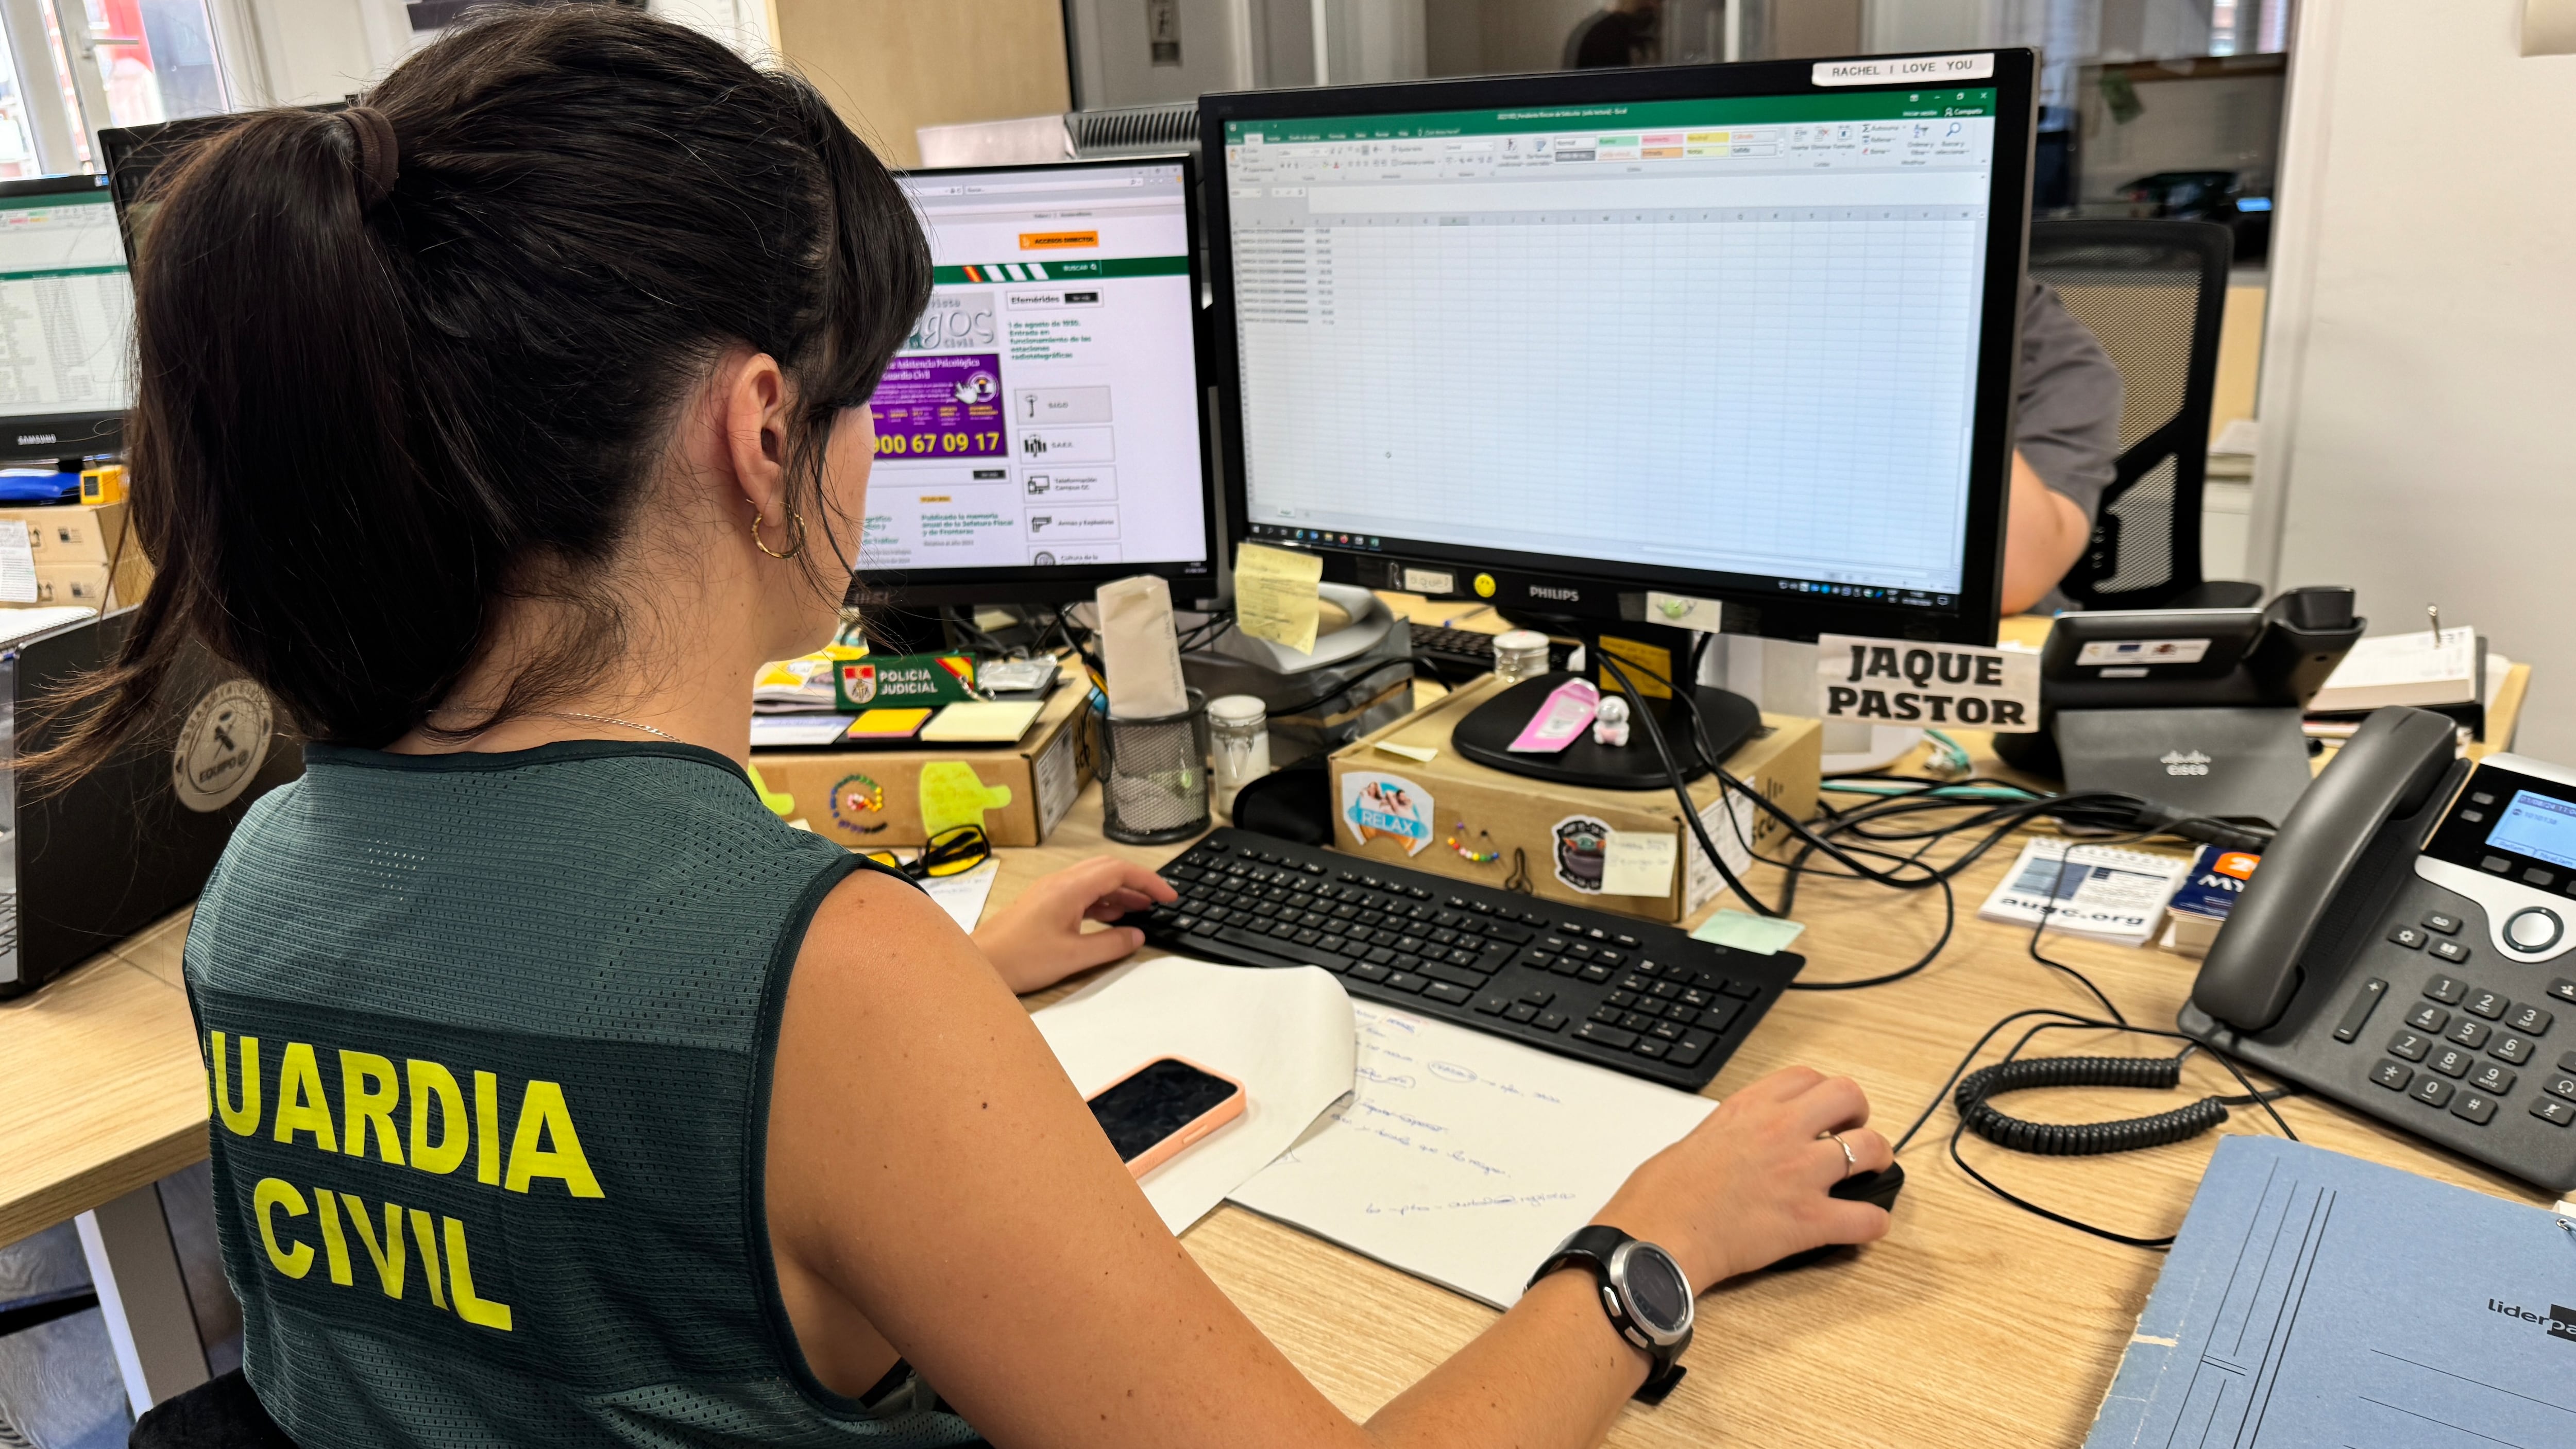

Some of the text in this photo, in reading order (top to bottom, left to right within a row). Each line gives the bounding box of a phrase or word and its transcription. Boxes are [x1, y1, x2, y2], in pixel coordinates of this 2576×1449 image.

[1832, 60, 1973, 77] RACHEL I LOVE YOU
[911, 433, 937, 453] 67
[943, 432, 969, 452] 09
[975, 431, 1000, 451] 17
[1529, 585, 1580, 602] PHILIPS
[1848, 644, 2004, 688] JAQUE
[880, 680, 938, 695] JUDICIAL
[1827, 686, 2026, 725] PASTOR
[1361, 810, 1414, 836] RELAX
[2480, 994, 2495, 1007] 2
[2421, 1009, 2434, 1020] 4
[2523, 1009, 2537, 1022] 3
[2462, 1022, 2477, 1035] 5
[2403, 1036, 2417, 1047] 7
[2505, 1038, 2518, 1051] 6
[2444, 1052, 2458, 1065] 8
[2486, 1068, 2499, 1081] 9
[2426, 1081, 2438, 1094] 0
[204, 1030, 605, 1199] UARDIA
[253, 1177, 513, 1332] CIVIL
